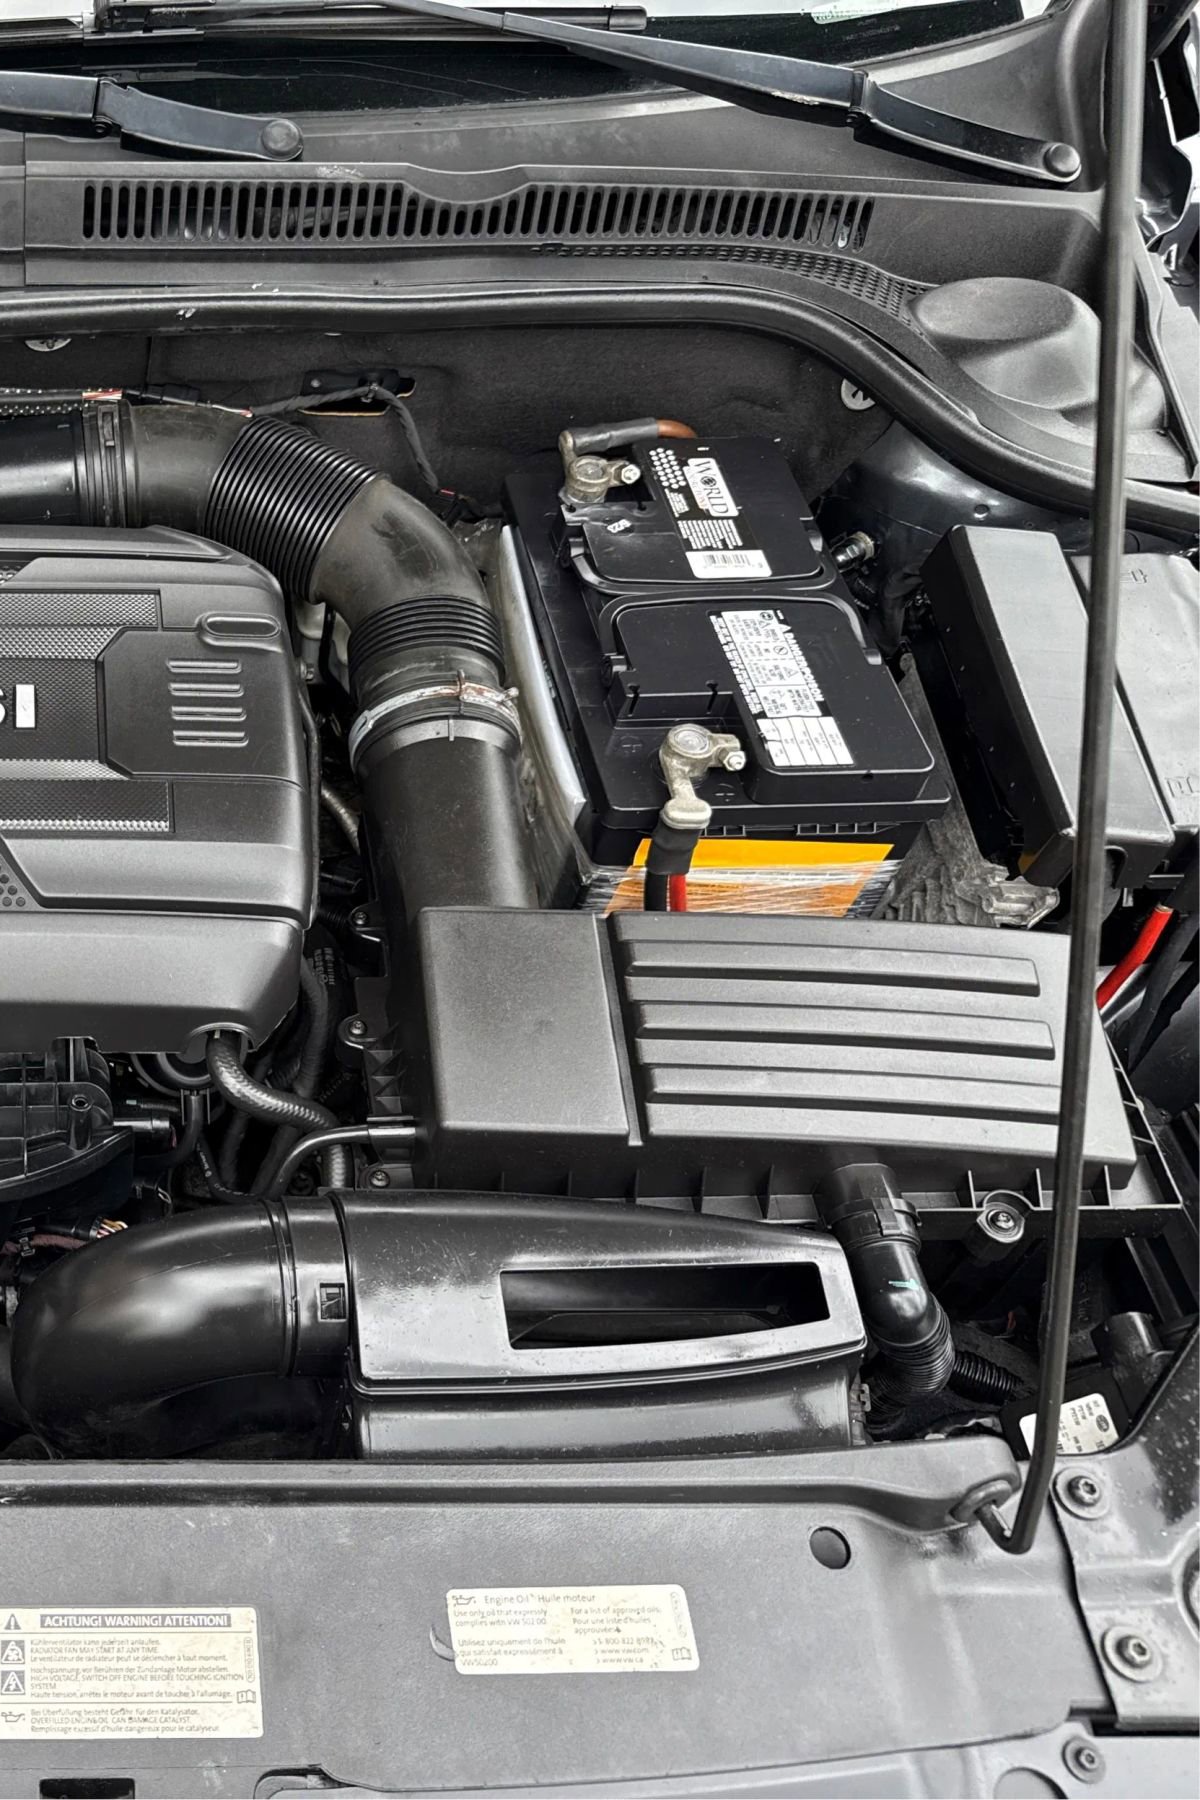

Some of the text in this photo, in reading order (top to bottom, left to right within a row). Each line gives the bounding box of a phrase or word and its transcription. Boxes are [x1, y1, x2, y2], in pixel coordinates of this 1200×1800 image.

[484, 1595, 514, 1606] Engine
[537, 1593, 561, 1603] Huile
[563, 1593, 596, 1603] moteur
[44, 1615, 228, 1626] ACHTUNG! WARNING! ATTENTION!
